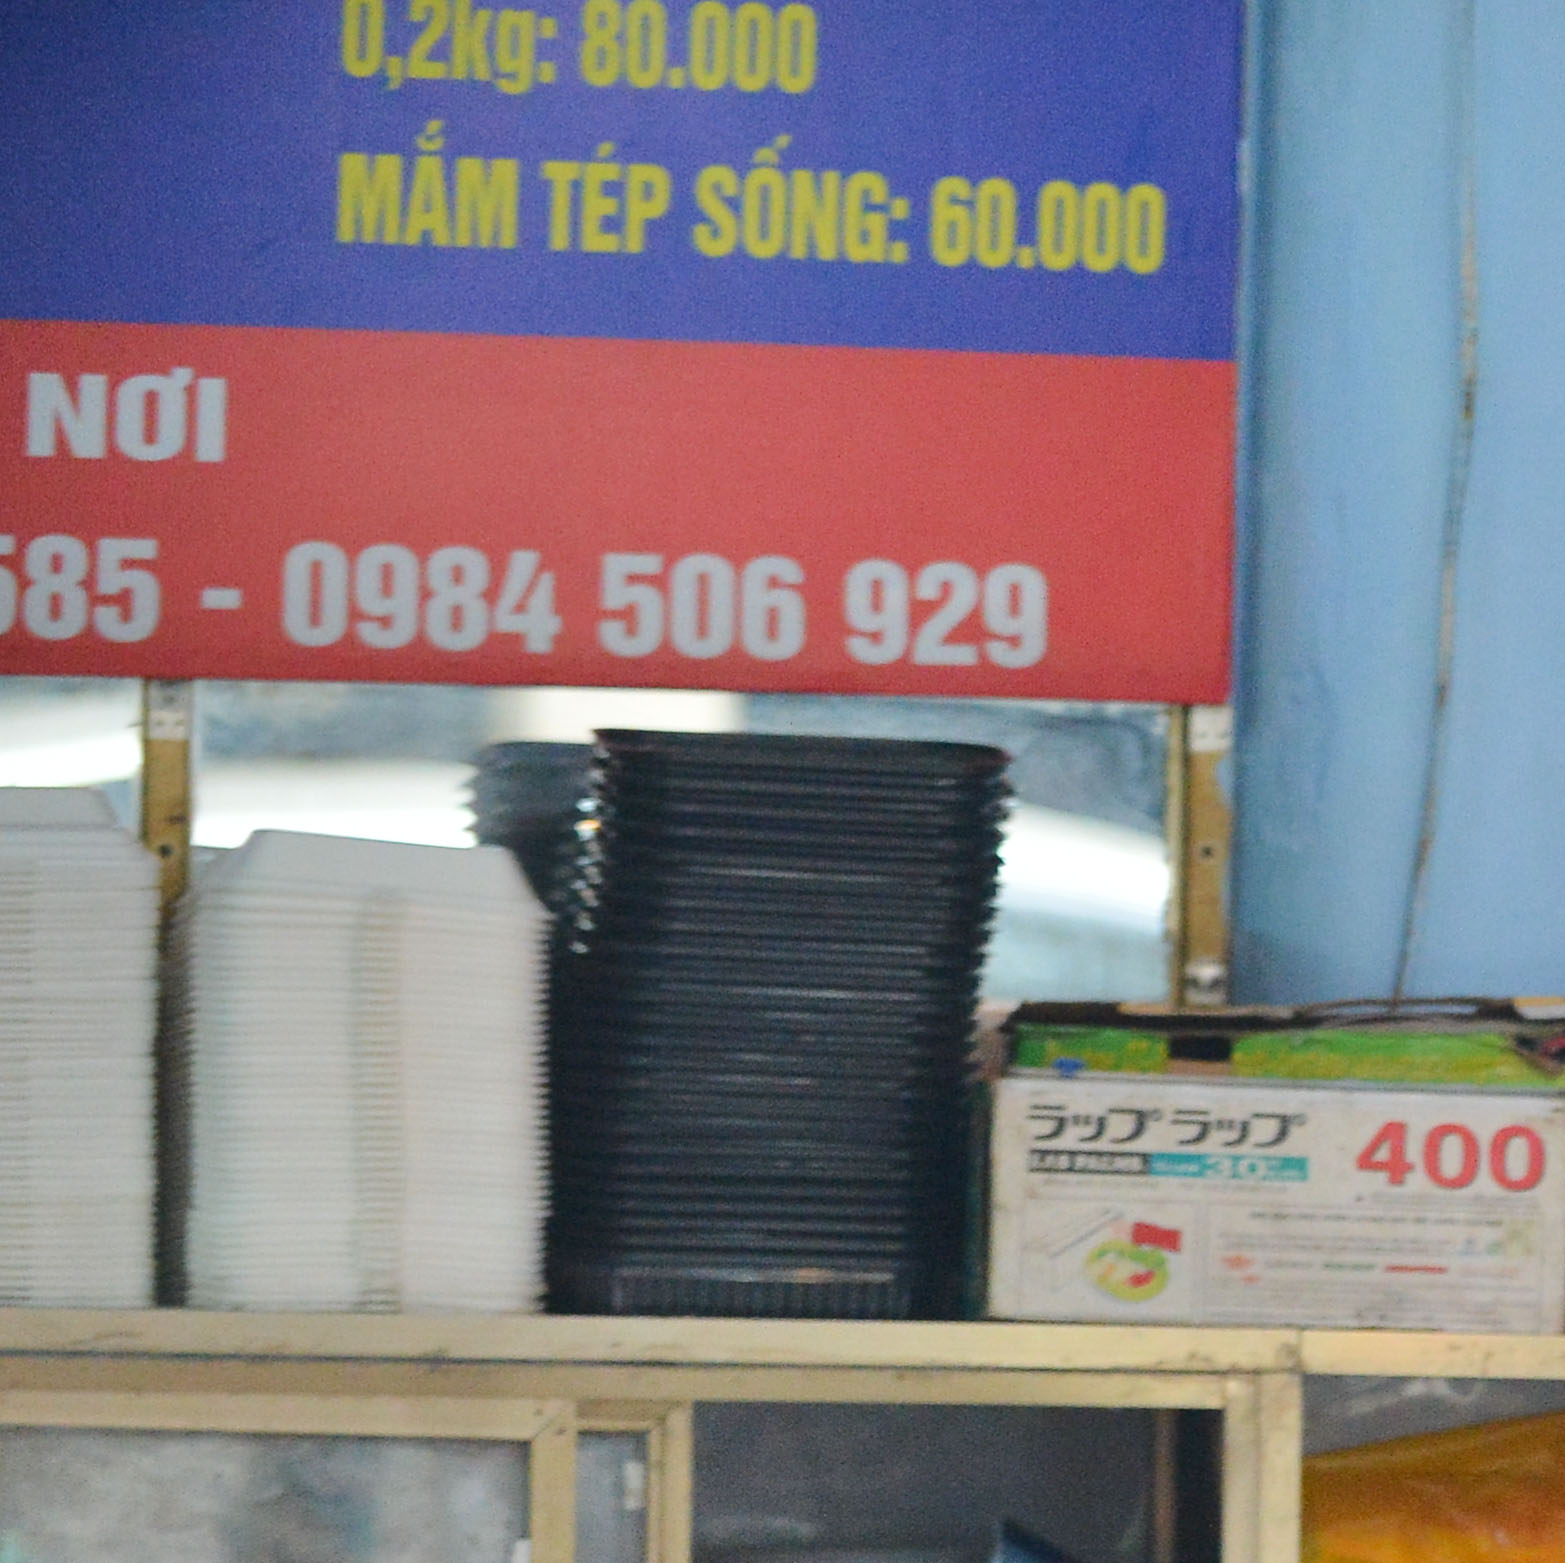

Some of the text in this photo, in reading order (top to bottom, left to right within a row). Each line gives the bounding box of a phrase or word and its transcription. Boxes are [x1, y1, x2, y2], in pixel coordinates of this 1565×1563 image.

[342, 0, 818, 94] 0,2kg: 80.000
[336, 119, 1167, 275] MẮM TÉP SỐNG: 60.000
[24, 366, 228, 463] NƠI
[0, 534, 1050, 669] 85 - 0984 506 929
[1356, 1121, 1546, 1192] 400
